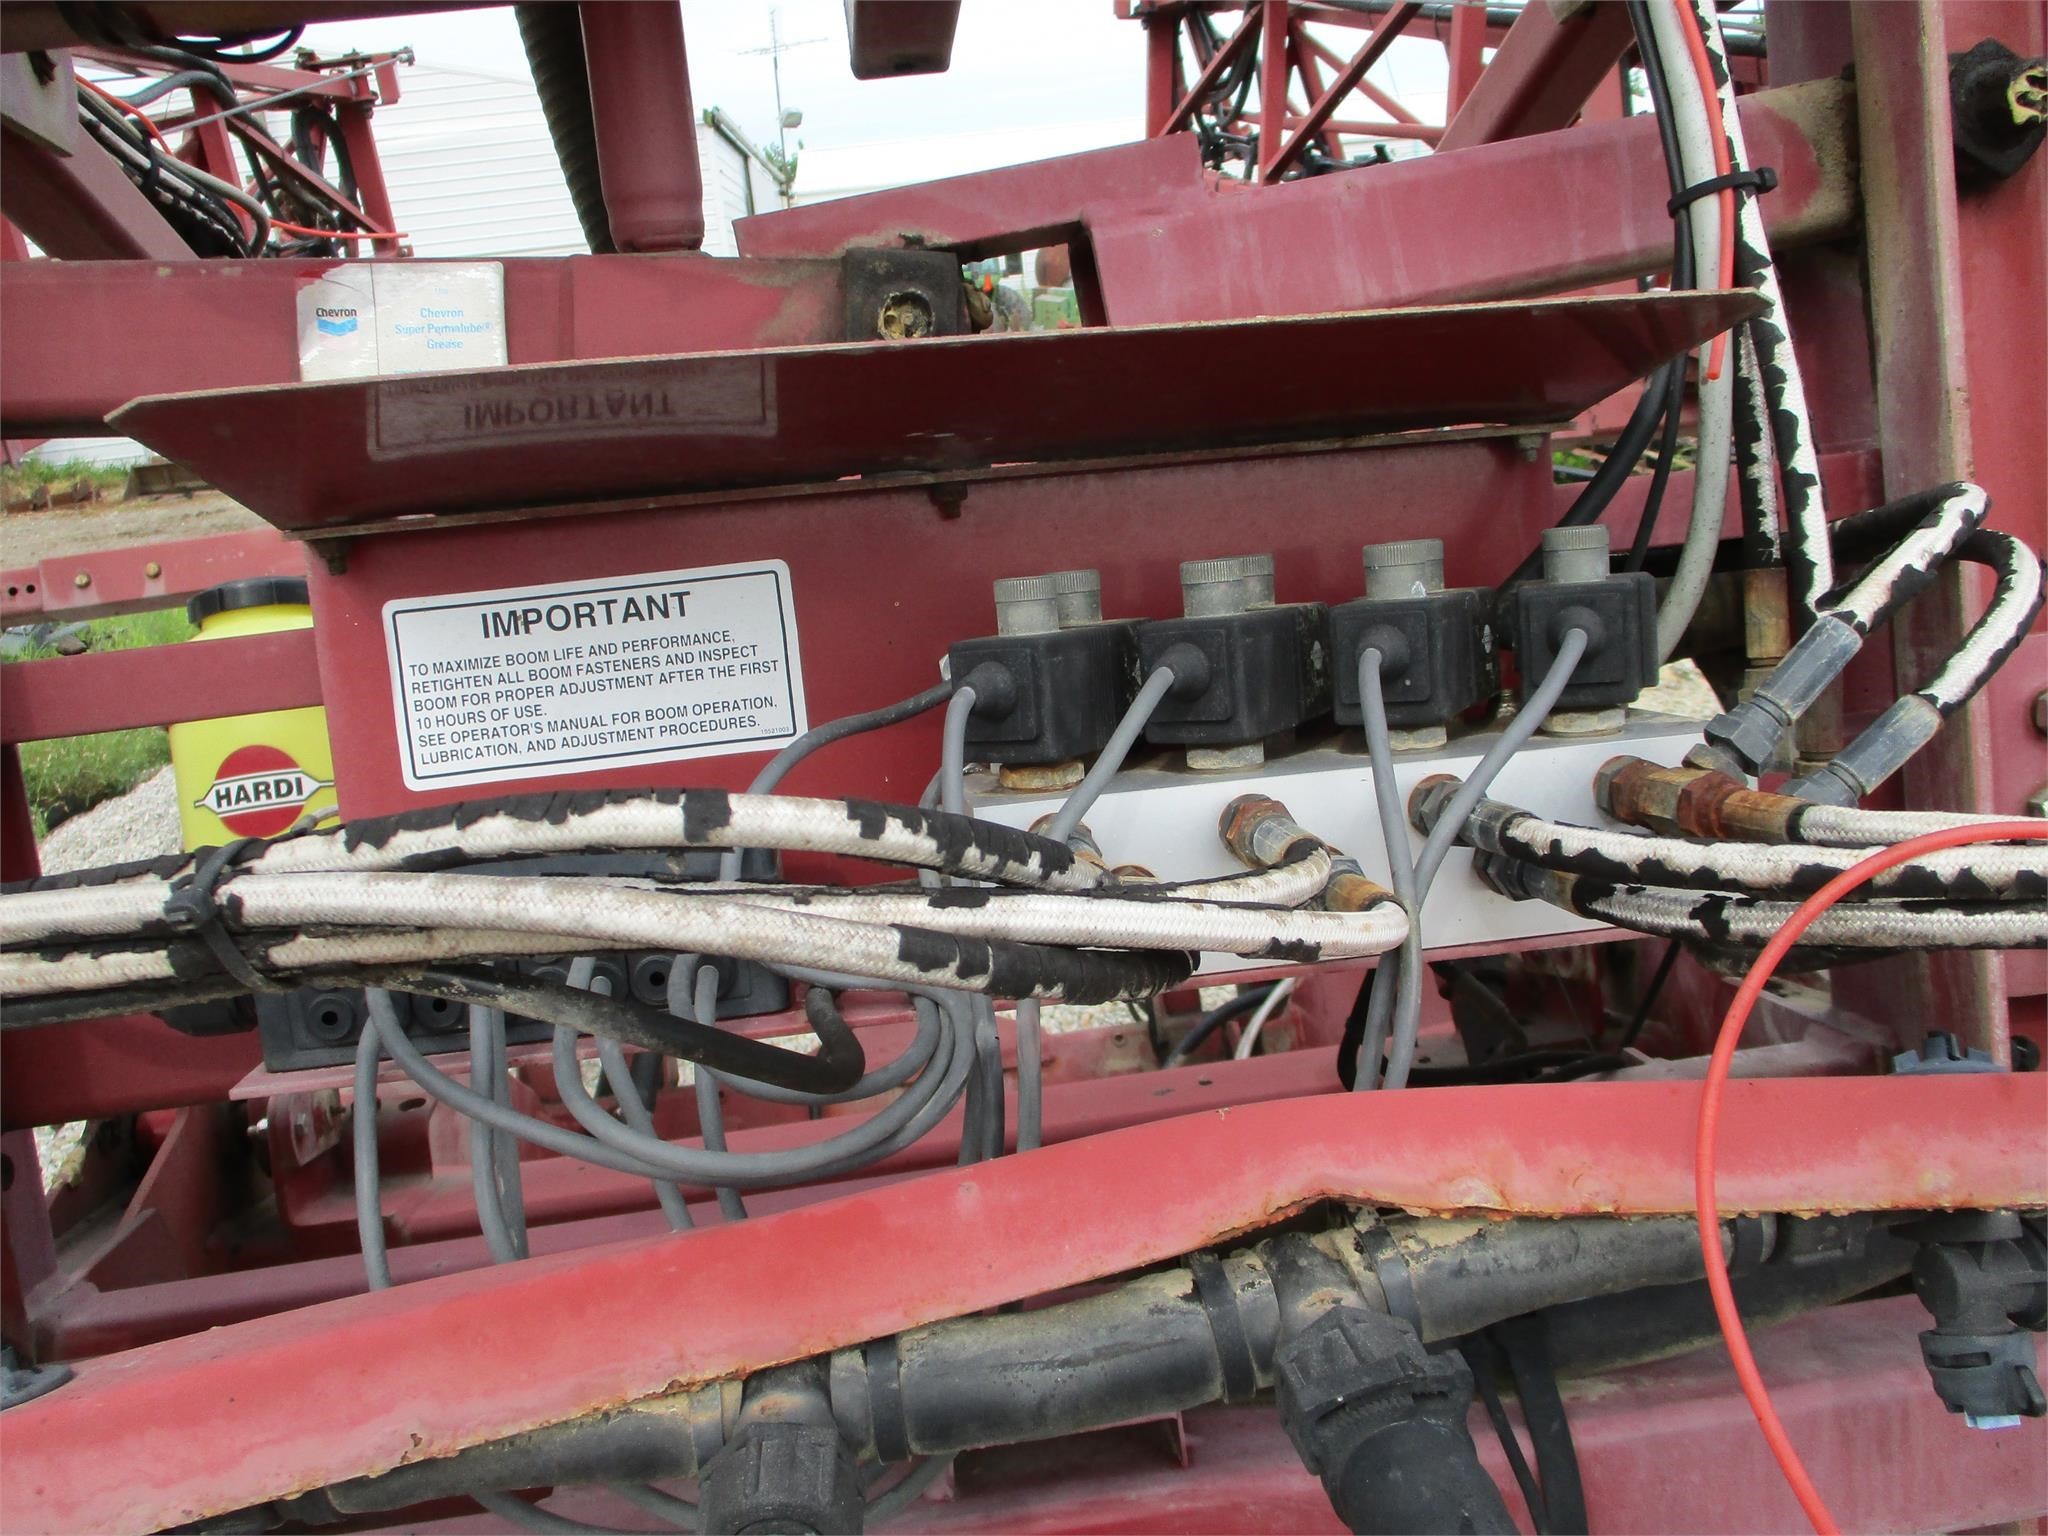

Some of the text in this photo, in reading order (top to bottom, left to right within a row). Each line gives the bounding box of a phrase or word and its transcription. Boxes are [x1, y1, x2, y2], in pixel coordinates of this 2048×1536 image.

[316, 307, 357, 318] Chevron
[395, 324, 426, 335] Super
[420, 308, 464, 319] Chevron
[427, 339, 464, 349] Grease
[481, 591, 691, 639] IMPORTANT
[409, 630, 736, 677] TO MAXIMIZE BOOM LIFE AND PERFORMANCE,
[412, 645, 758, 694] RETIGHTEN ALL BOOM FASTENERS AND INSPECT
[414, 660, 779, 712] BOOM FOR PROPER ADJUSTMENT AFTER THE FIRST
[416, 703, 548, 729] 10 HOURS OF USE.
[418, 733, 446, 747] SEE
[450, 721, 544, 744] OPERATOR'S
[547, 714, 608, 733] MANUAL
[612, 711, 641, 725] FOR
[645, 705, 688, 722] BOOM
[421, 715, 761, 765] LUBRICATION, AND ADJUSTMENT PROCEDURES.
[215, 776, 303, 809] HARDI
